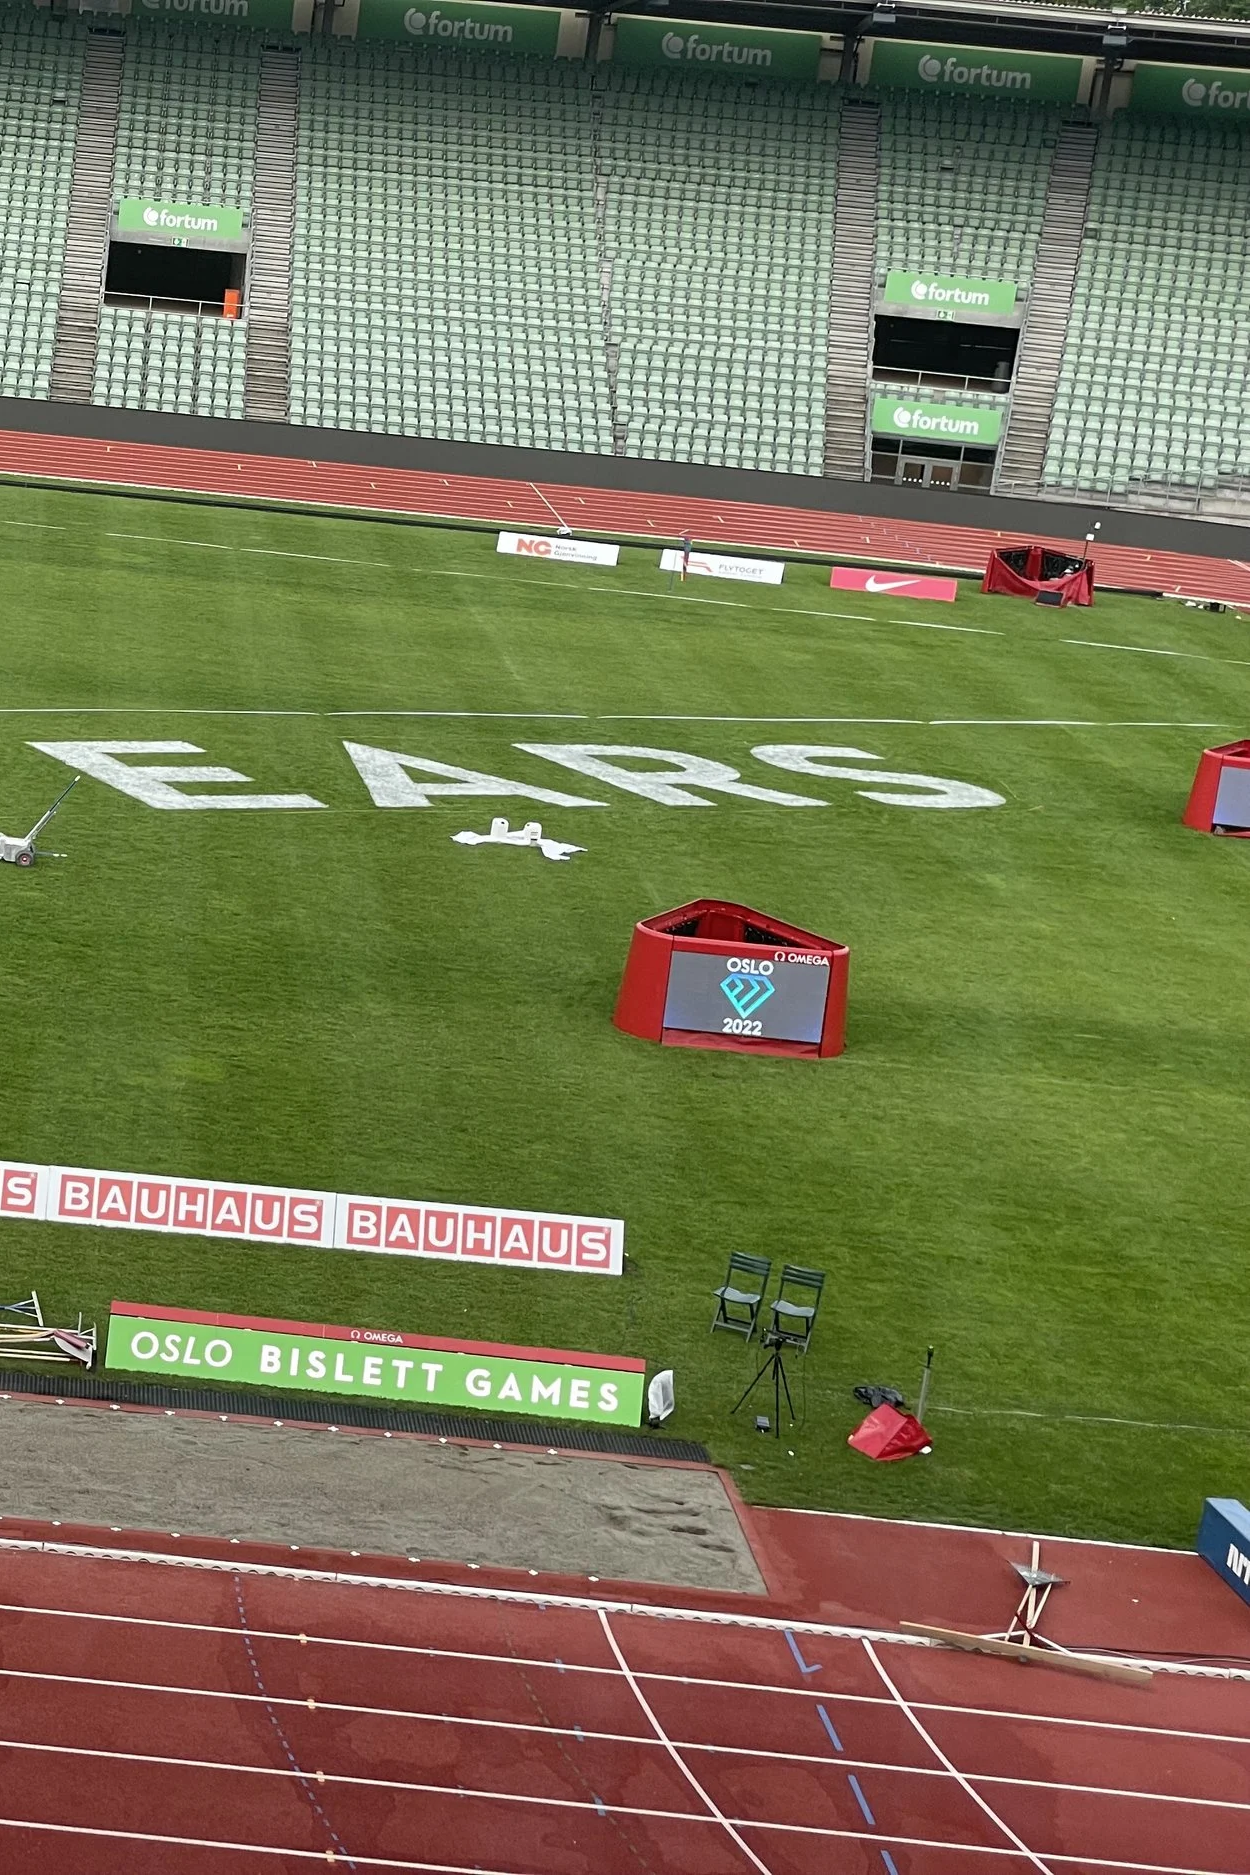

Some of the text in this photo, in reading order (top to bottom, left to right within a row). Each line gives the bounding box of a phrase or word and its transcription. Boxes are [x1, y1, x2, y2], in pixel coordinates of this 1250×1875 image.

[428, 10, 513, 43] fortum
[685, 34, 772, 66] fortum
[943, 57, 1032, 89] fortum
[160, 208, 218, 231] fortum
[928, 282, 990, 306] fortum
[912, 409, 980, 435] fortum
[516, 538, 552, 556] NG
[726, 957, 775, 976] OSLO
[787, 952, 830, 967] OMEGA
[722, 1017, 763, 1037] 2022
[63, 1180, 320, 1234] BAUHAUS
[351, 1208, 609, 1262] BAUHAUS
[363, 1331, 404, 1344] OMEGA
[130, 1331, 619, 1412] OSLO BISLETT GAMES
